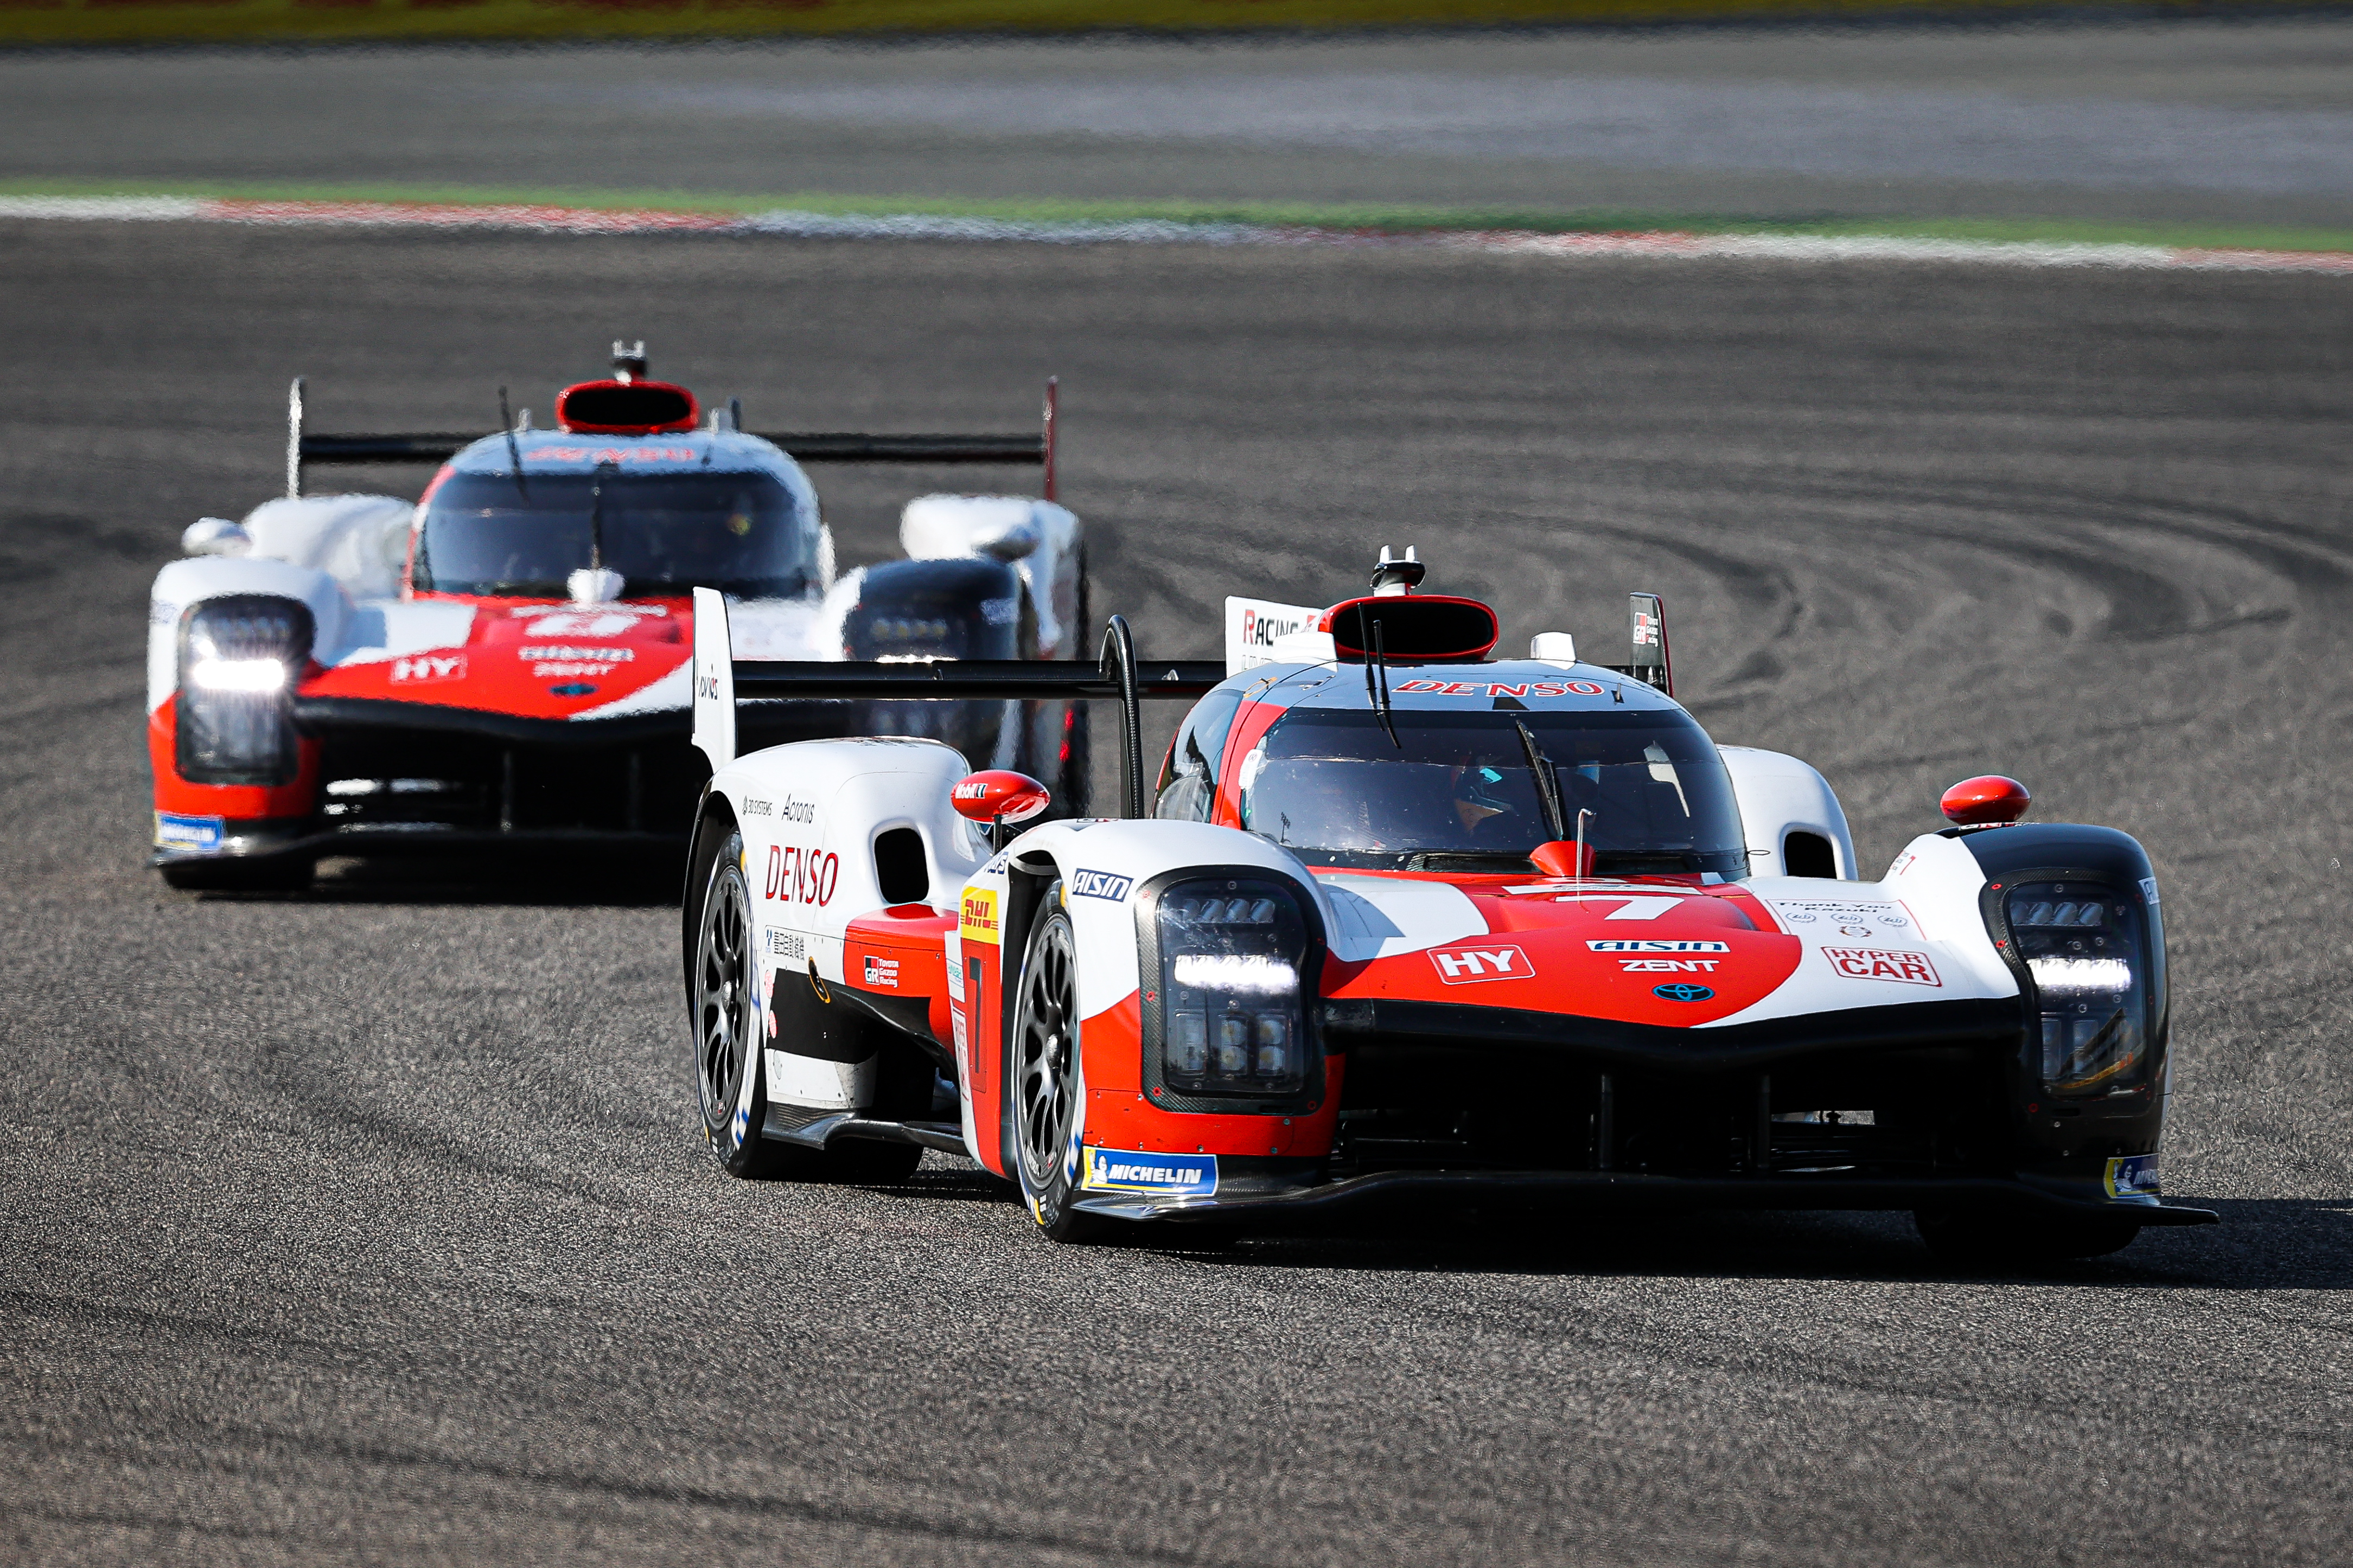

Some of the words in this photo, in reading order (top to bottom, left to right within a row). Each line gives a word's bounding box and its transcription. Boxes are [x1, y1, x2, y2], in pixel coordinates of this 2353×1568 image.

[1392, 680, 1605, 697] DENSO
[955, 783, 978, 799] Mobil
[754, 800, 772, 816] SYSTEMS
[782, 793, 815, 824] Acronis
[766, 844, 838, 907] DENSO
[1073, 871, 1130, 900] AISIN
[965, 899, 990, 928] DHL
[1555, 895, 1685, 920] 7
[1594, 942, 1724, 951] AISIN
[1831, 949, 1923, 964] HYPER
[1437, 950, 1515, 977] HY
[1618, 959, 1719, 971] ZENT
[1839, 959, 1931, 982] CAR
[865, 968, 878, 983] GR
[970, 955, 981, 1073] 7
[1108, 1164, 1202, 1184] MICHELIN
